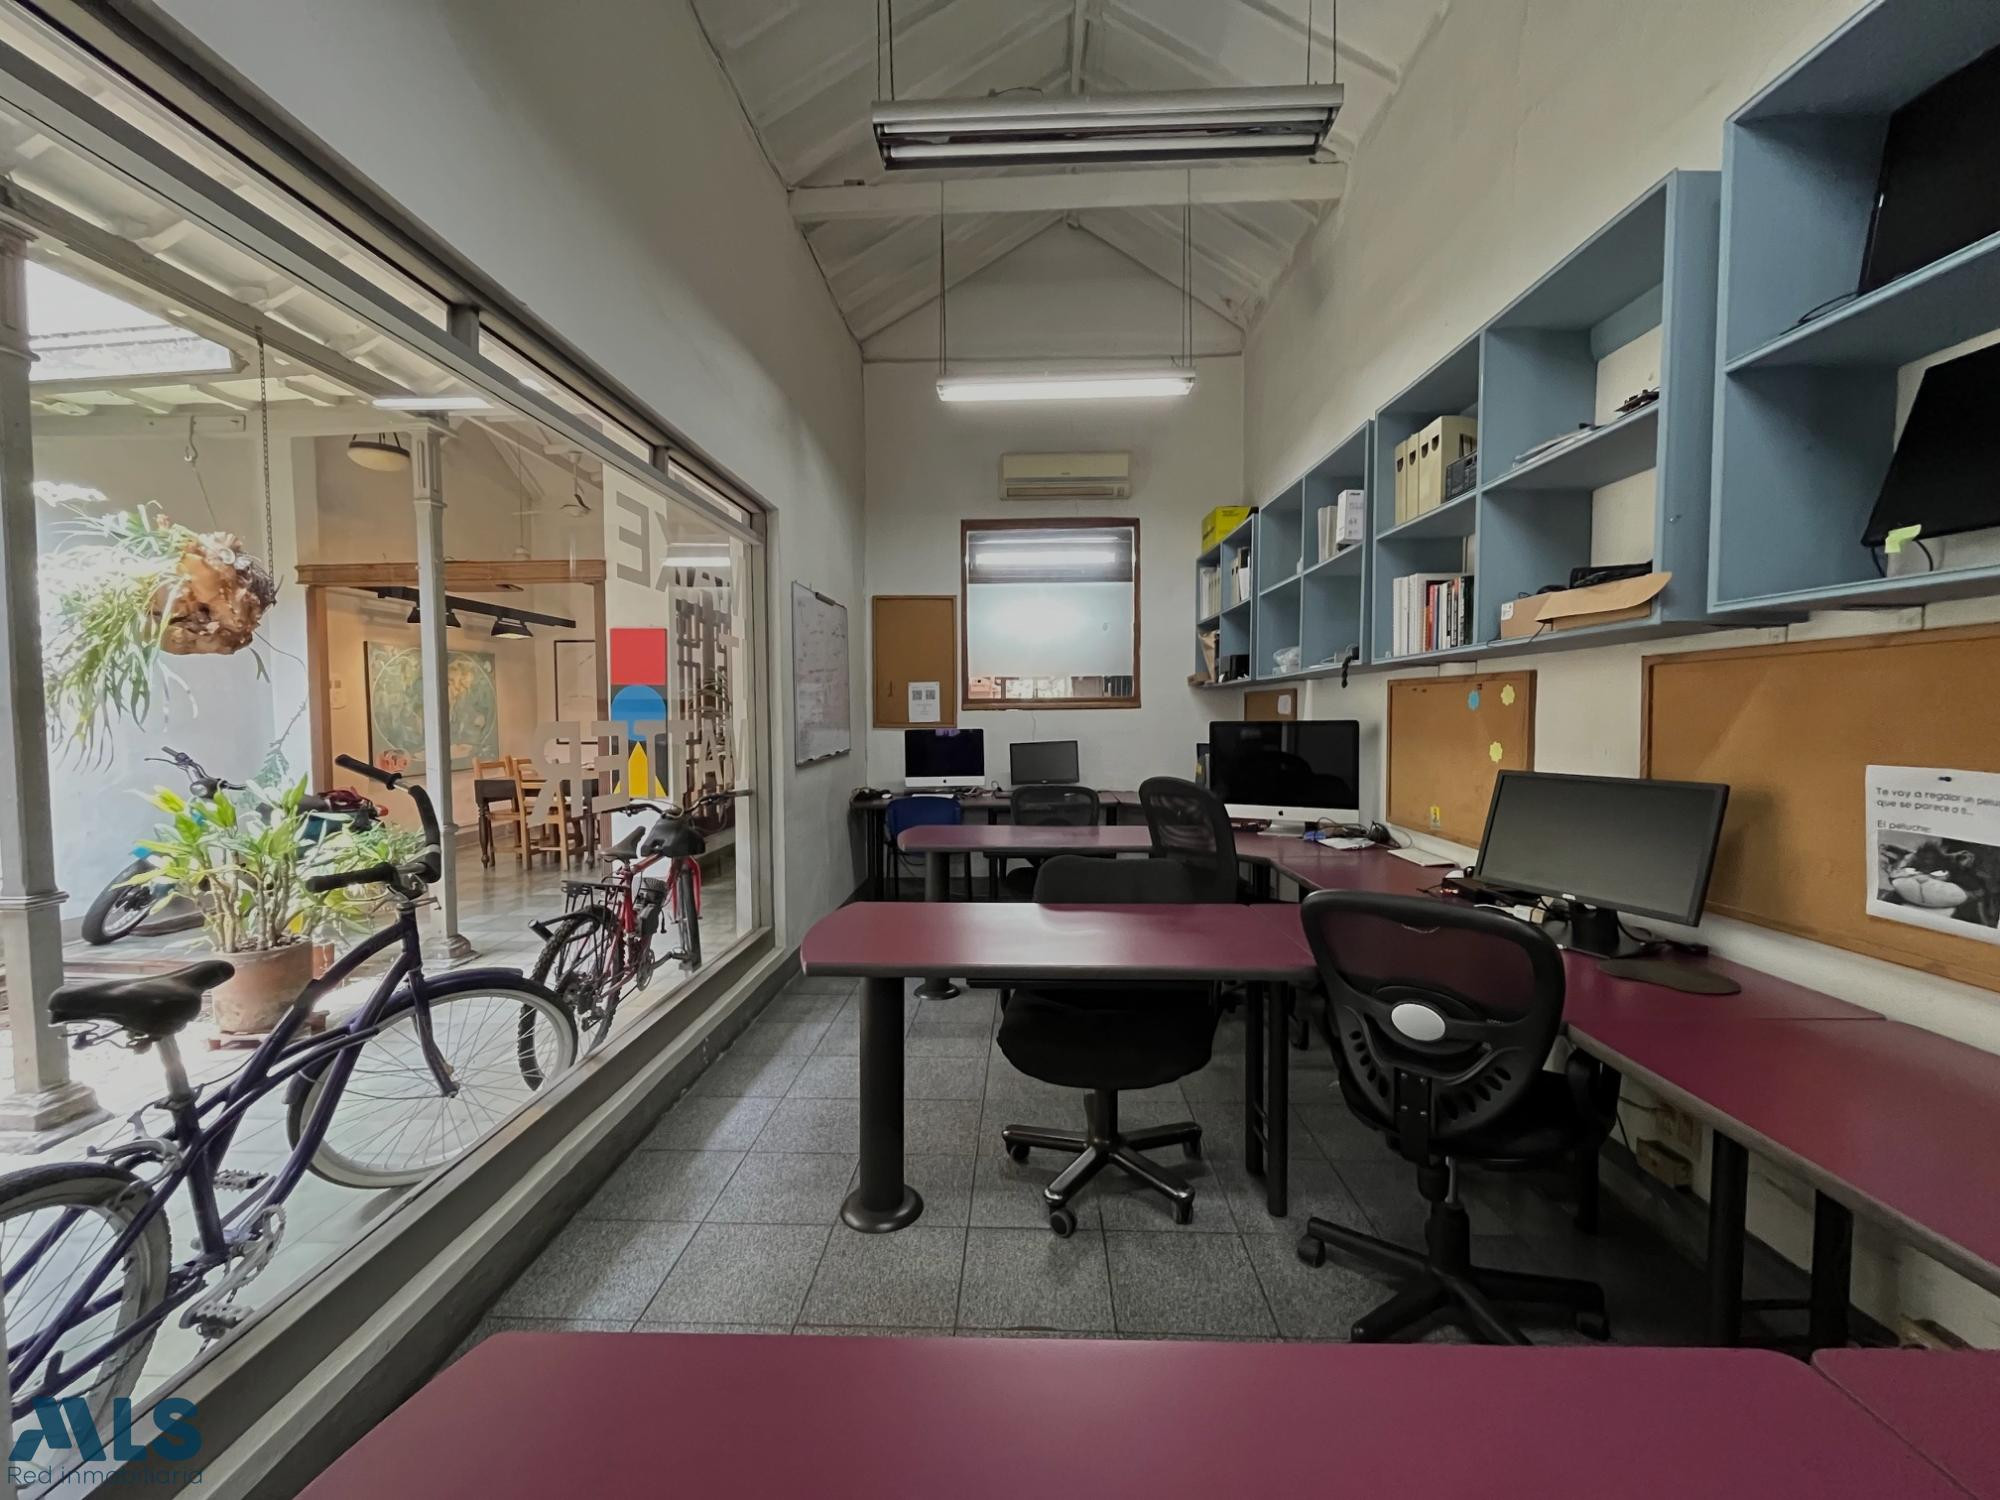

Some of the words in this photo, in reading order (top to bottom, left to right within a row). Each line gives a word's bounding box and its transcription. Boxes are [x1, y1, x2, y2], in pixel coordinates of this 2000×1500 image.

[1875, 787, 1889, 797] Te
[1892, 790, 1911, 799] voy
[1914, 791, 1922, 799] a
[1924, 792, 1962, 802] regalar
[1877, 799, 1897, 808] que
[1900, 801, 1911, 809] se
[1914, 802, 1950, 813] parece
[1951, 806, 1959, 814] a
